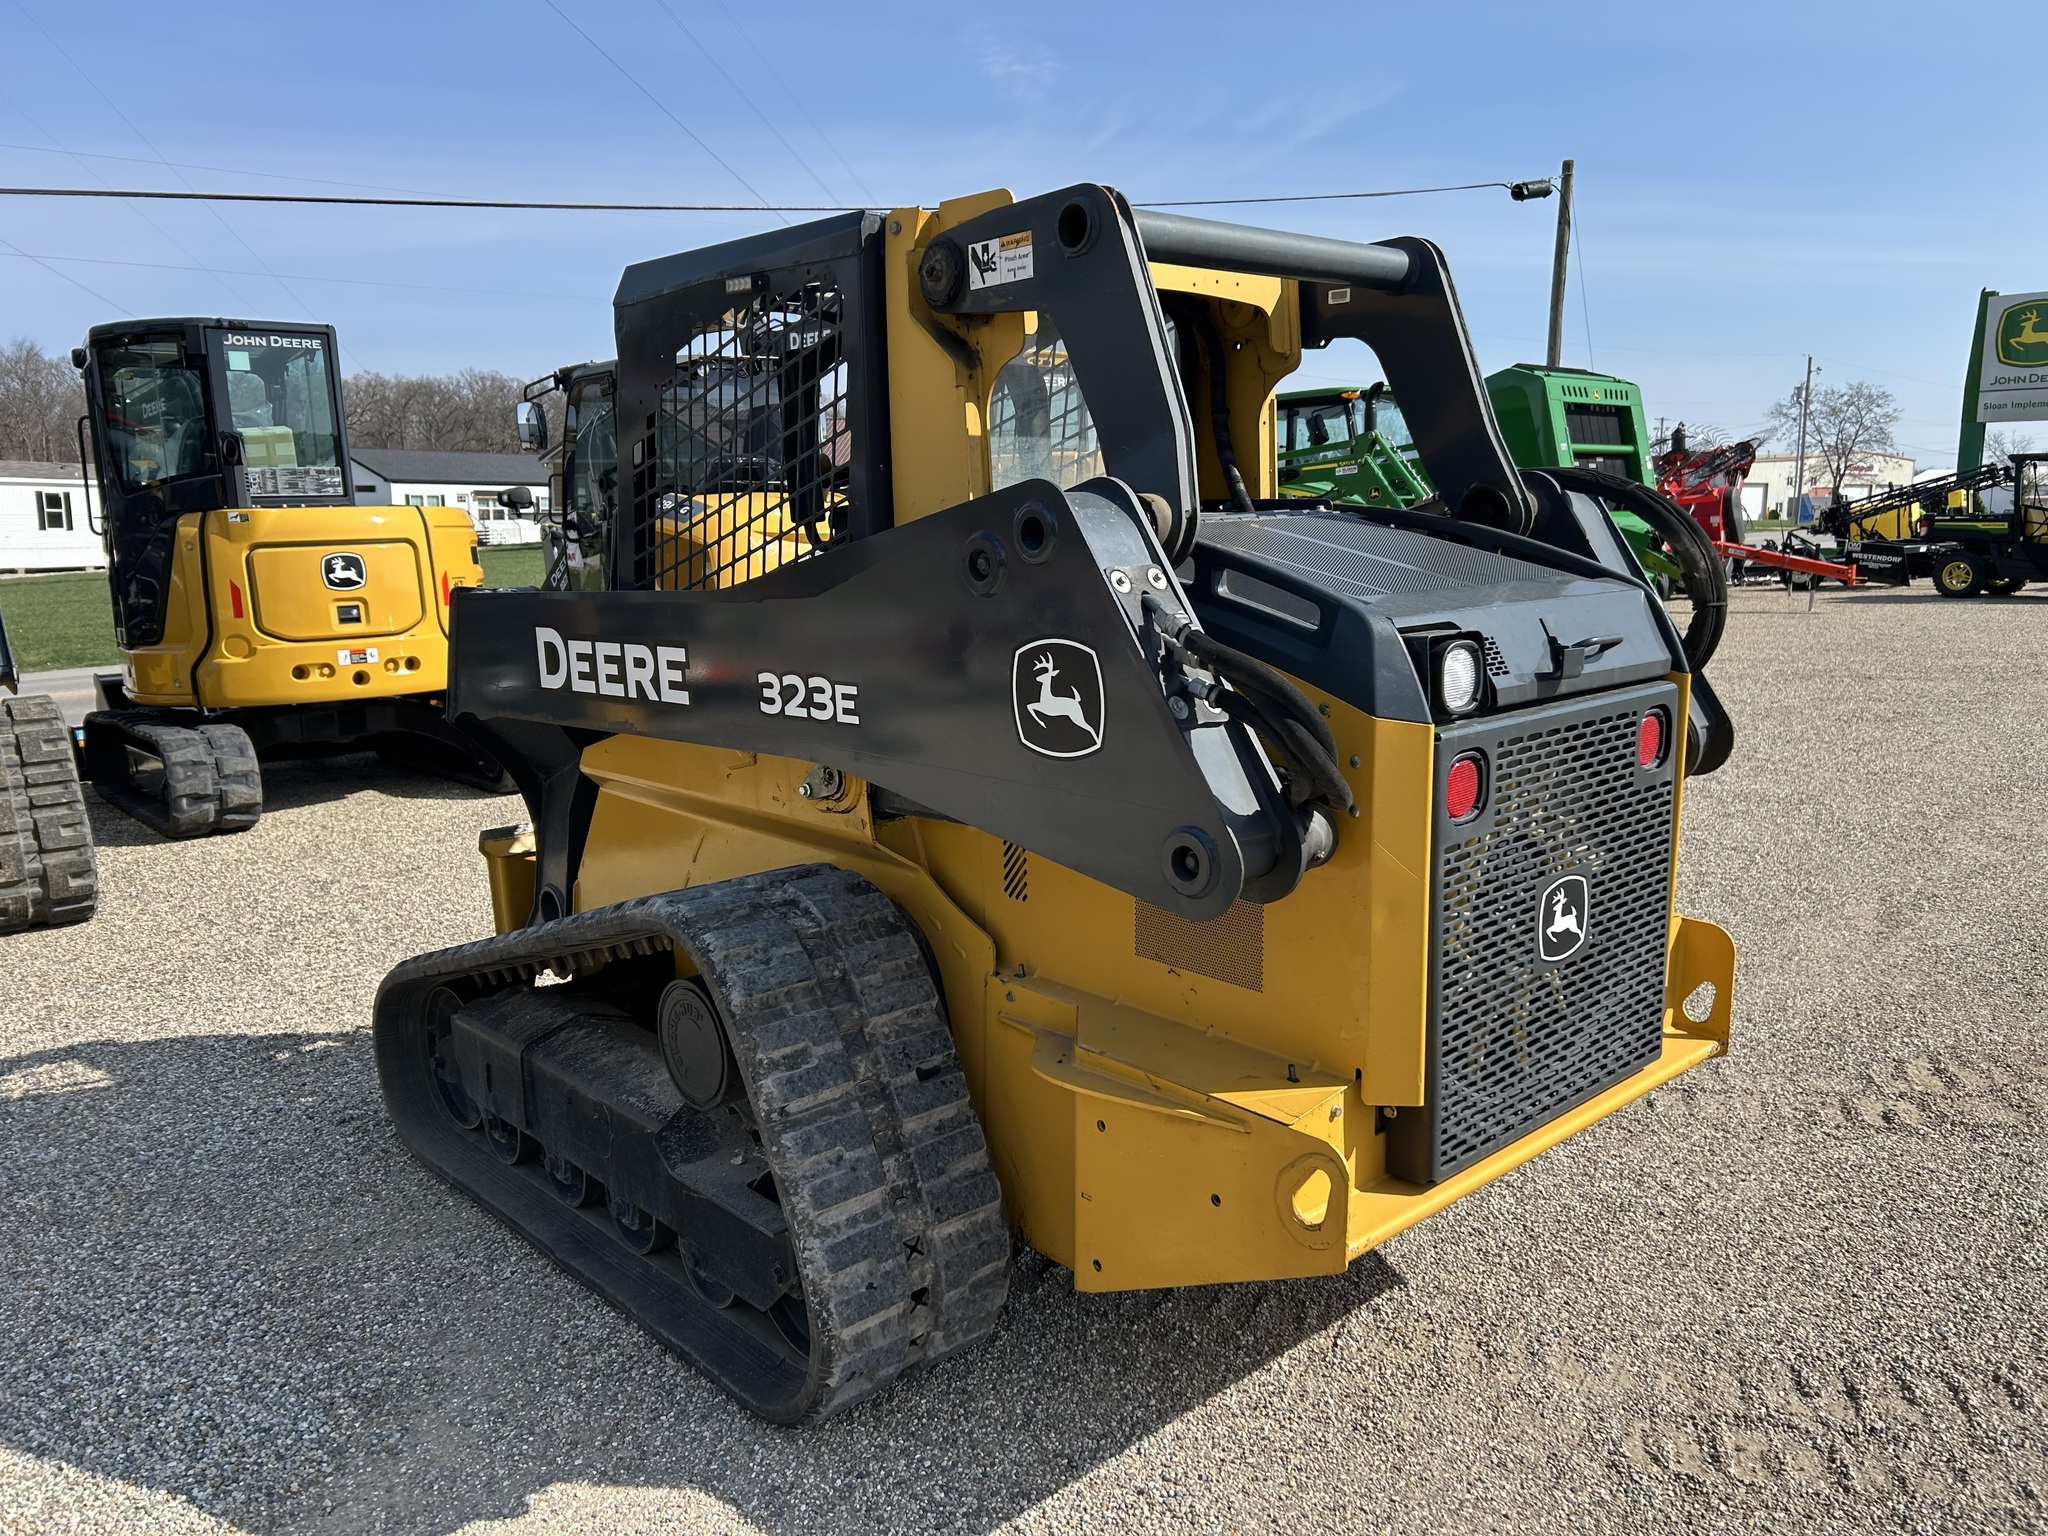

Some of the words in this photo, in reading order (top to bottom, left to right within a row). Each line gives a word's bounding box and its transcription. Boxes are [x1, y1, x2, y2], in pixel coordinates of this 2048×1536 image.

[1006, 235, 1030, 247] WARNING
[1004, 254, 1017, 263] Pinch
[223, 333, 267, 347] JOHN
[270, 336, 322, 349] DEERE
[1989, 375, 2027, 386] JOHN
[1983, 402, 2008, 410] Sloan
[1852, 552, 1903, 563] WESTENDORF
[535, 626, 690, 706] DEERE
[757, 671, 860, 725] 323E
